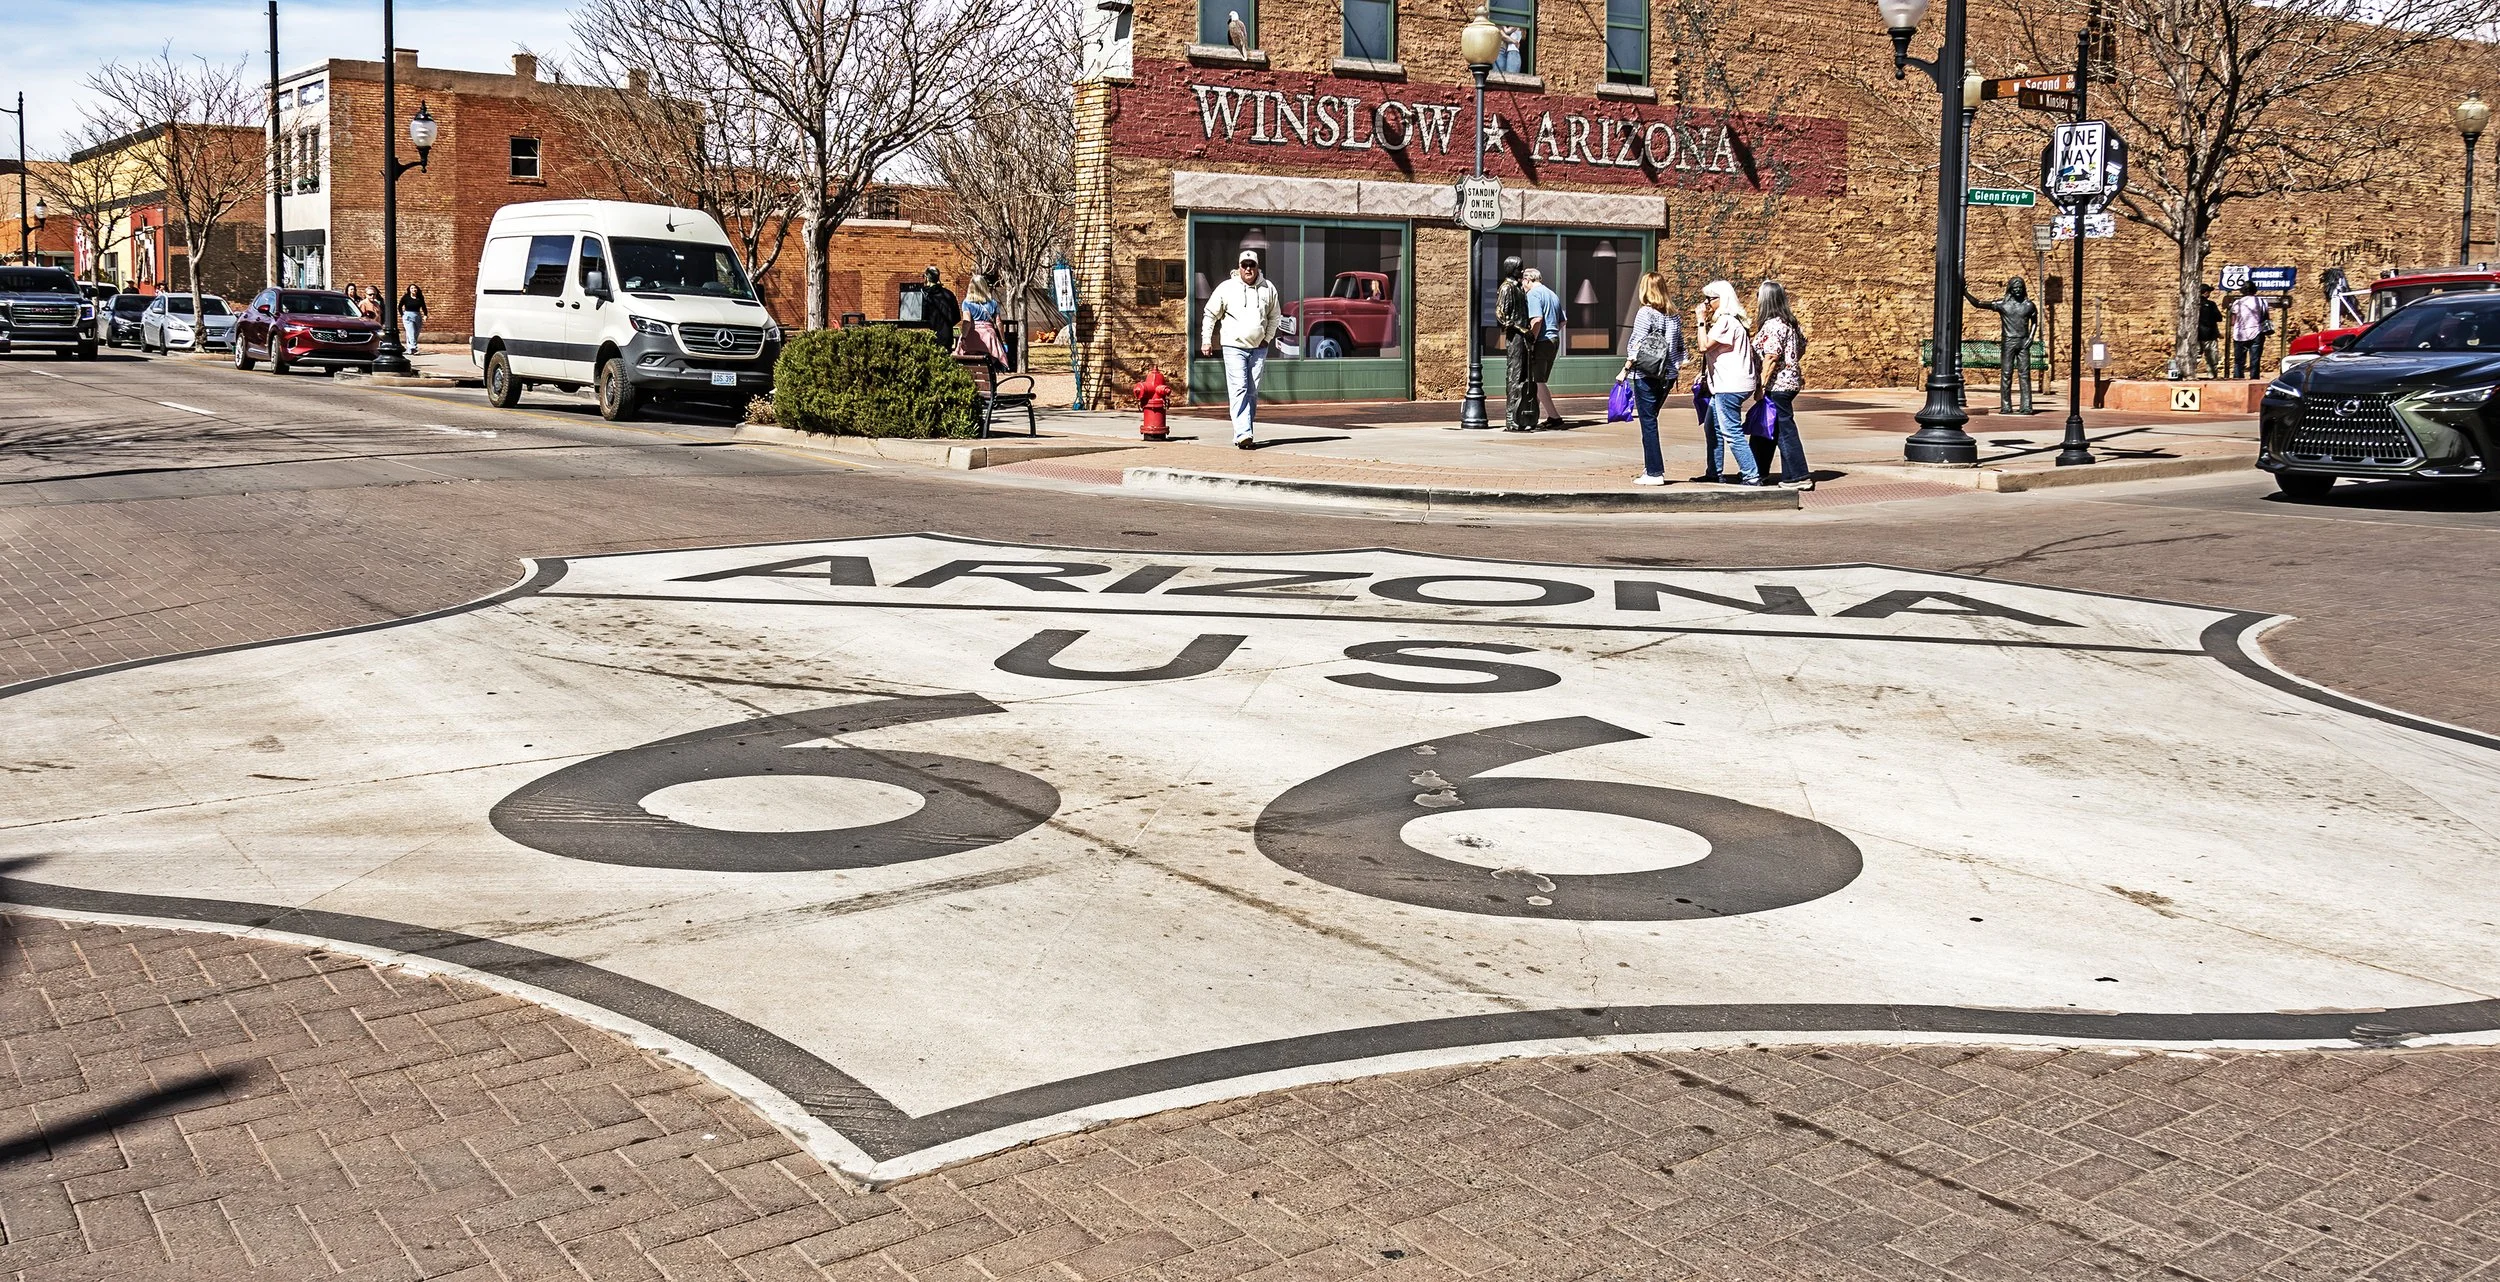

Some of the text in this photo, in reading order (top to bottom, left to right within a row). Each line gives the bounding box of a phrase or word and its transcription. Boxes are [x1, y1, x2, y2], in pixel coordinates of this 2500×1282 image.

[2025, 77, 2060, 91] Second
[2046, 94, 2069, 110] Kinsley
[1191, 84, 1737, 173] WINSLOW ARIZONA
[2062, 129, 2097, 147] ONE
[2061, 148, 2098, 166] WAY
[1468, 188, 1498, 197] STANDIN'
[1974, 190, 2000, 201] Glenn
[2001, 191, 2021, 204] Frey
[1471, 199, 1494, 208] ON THE
[1470, 210, 1495, 219] CORNER
[2226, 274, 2246, 288] 66
[2252, 280, 2291, 288] TTRACTION
[665, 554, 2086, 627] ARIZONA
[994, 629, 1562, 693] US
[488, 692, 1864, 921] 66
